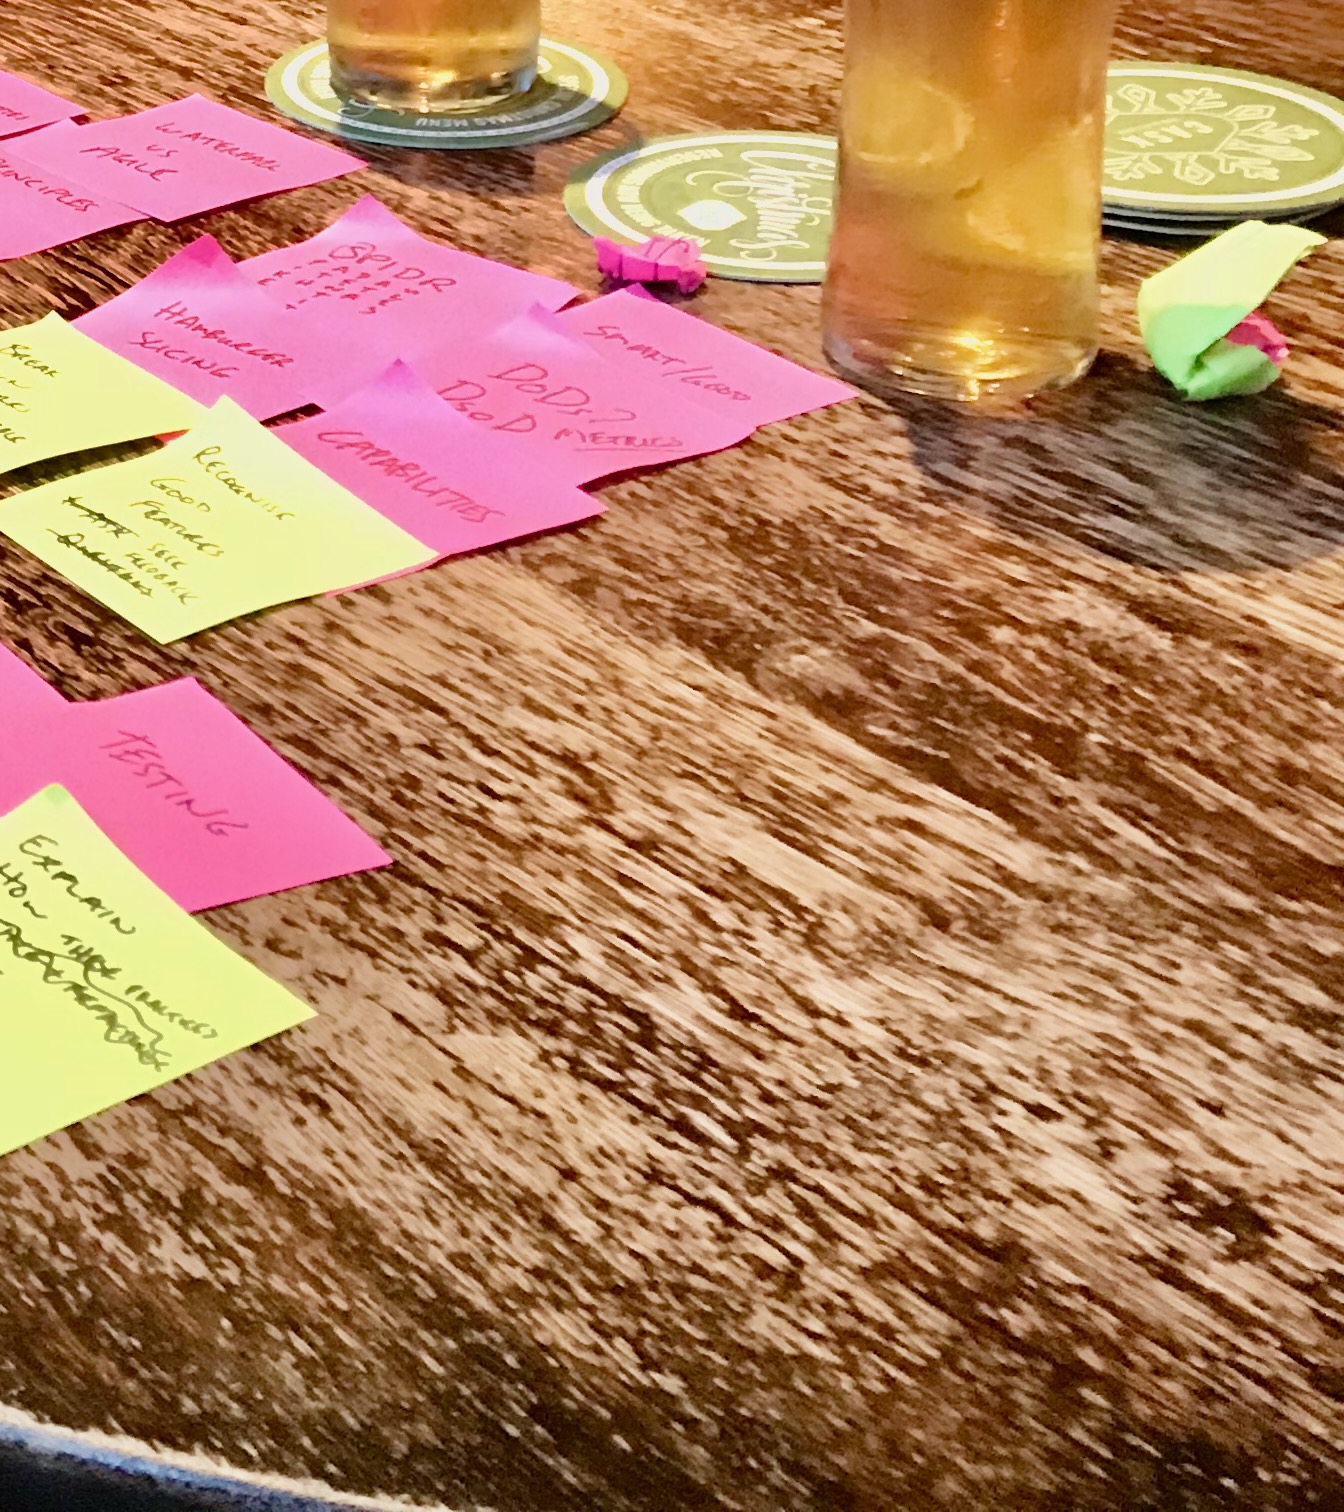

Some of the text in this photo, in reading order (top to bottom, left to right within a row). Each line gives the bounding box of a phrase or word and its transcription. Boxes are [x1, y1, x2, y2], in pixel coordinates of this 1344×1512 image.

[155, 122, 280, 172] WATERFALL
[415, 116, 469, 128] MENU
[1120, 120, 1213, 149] CASK
[80, 145, 178, 181] AGILE
[712, 151, 836, 260] Christmas
[128, 331, 239, 379] SLICING
[153, 300, 294, 368] HAMBURGER
[149, 477, 212, 513] GOOD
[316, 431, 507, 524] CAPABILITIES
[98, 728, 248, 838] TESTING
[18, 833, 136, 935] EXPLAIN
